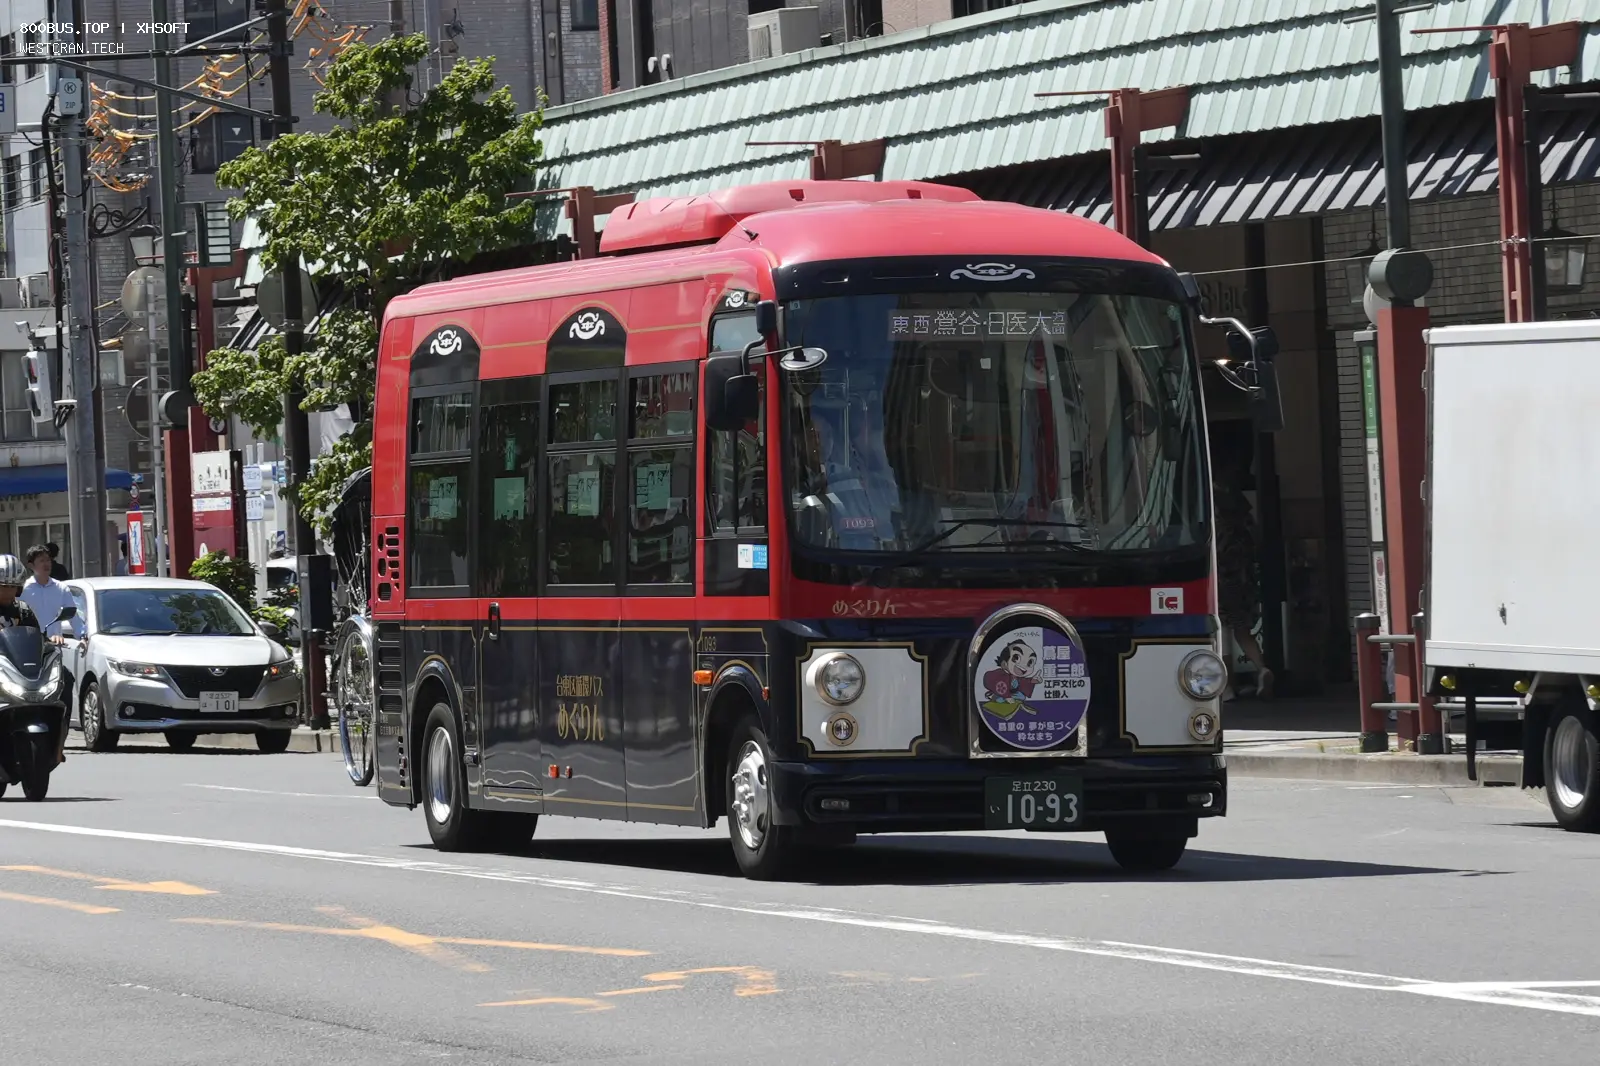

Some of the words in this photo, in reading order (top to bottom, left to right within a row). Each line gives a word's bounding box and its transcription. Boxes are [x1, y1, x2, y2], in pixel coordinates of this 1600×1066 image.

[844, 518, 875, 529] 1093
[831, 598, 897, 616] めぐりん
[1042, 663, 1085, 678] 重三郎
[1044, 679, 1086, 689] 江戸文化の
[1044, 690, 1069, 699] 仕掛人
[557, 702, 605, 741] めぐりん
[1028, 721, 1072, 732] 夢が息づく
[1017, 732, 1053, 741] 粋なまち
[989, 804, 1001, 814] い
[1007, 793, 1078, 824] 10-93
